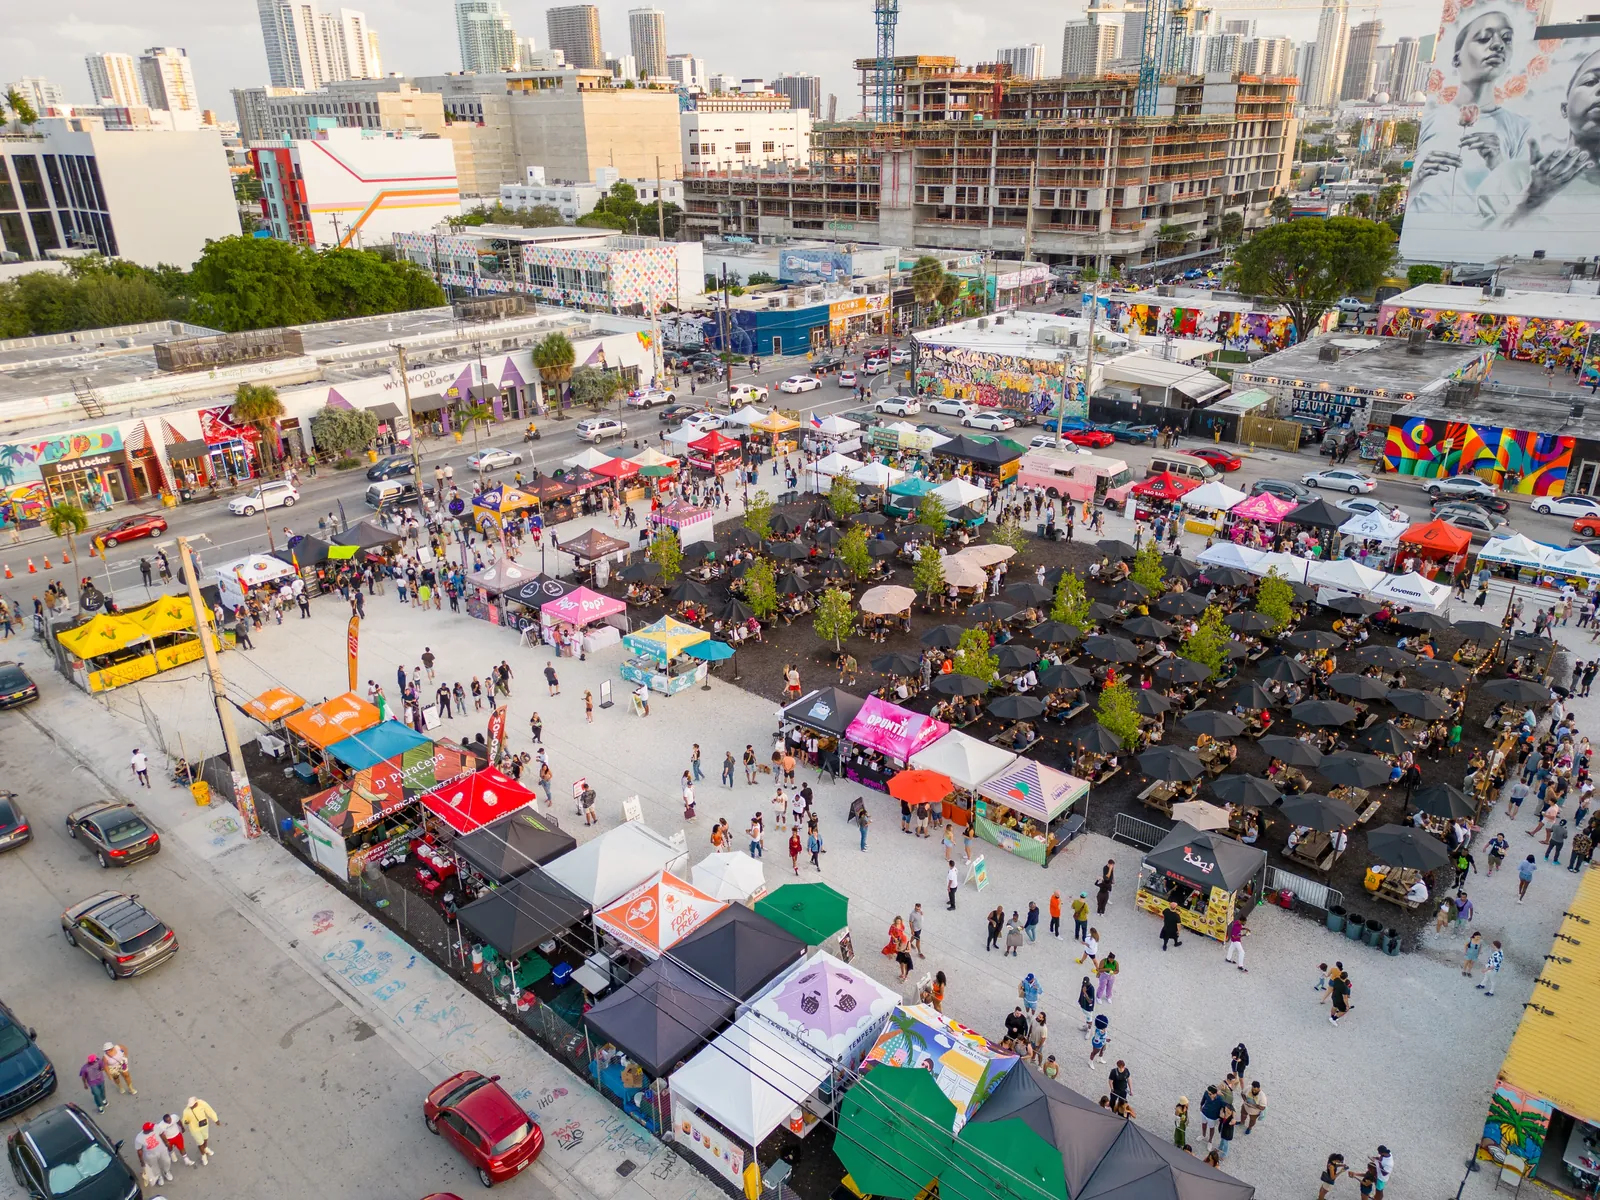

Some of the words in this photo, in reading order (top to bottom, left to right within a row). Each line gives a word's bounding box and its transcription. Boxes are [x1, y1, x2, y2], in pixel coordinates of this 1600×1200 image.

[423, 373, 455, 388] BLOCK
[1295, 389, 1310, 399] WE
[1312, 391, 1336, 401] LIVE
[1340, 395, 1351, 405] IN
[1293, 399, 1348, 414] BEAUTIFUL
[56, 461, 78, 473] Foot
[80, 455, 111, 468] Locker
[866, 714, 908, 738] OPUNTIA
[356, 808, 392, 829] PUERTO
[394, 793, 421, 812] RICAN
[422, 779, 453, 796] STREET
[454, 767, 477, 783] FOOD
[384, 834, 409, 849] MOFON
[671, 904, 696, 931] FORK
[676, 910, 700, 937] FREE
[848, 1023, 877, 1051] TEMPEST
[878, 1011, 891, 1025] TEA
[958, 1045, 974, 1057] KOREAN
